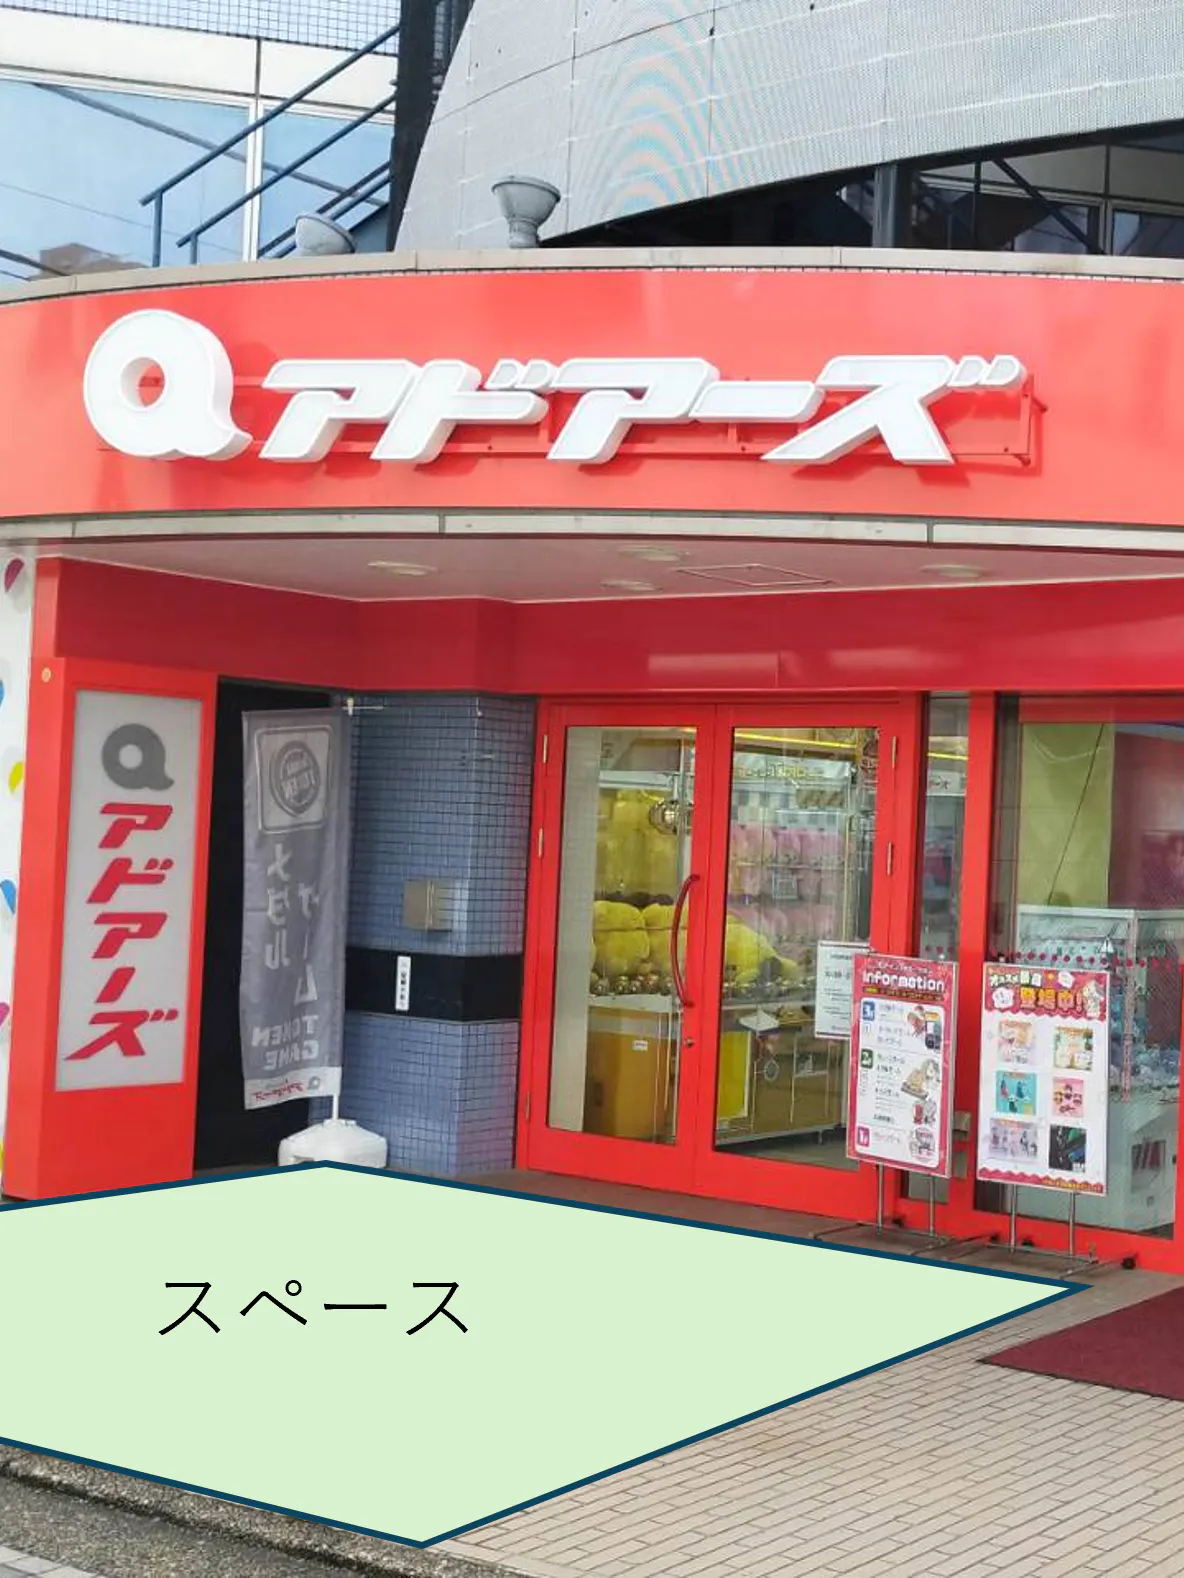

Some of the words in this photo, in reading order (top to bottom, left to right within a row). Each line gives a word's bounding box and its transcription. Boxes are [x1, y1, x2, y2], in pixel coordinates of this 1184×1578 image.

[259, 354, 1023, 465] アドアーズ
[64, 802, 179, 1061] アドアーズ
[862, 970, 945, 992] Information
